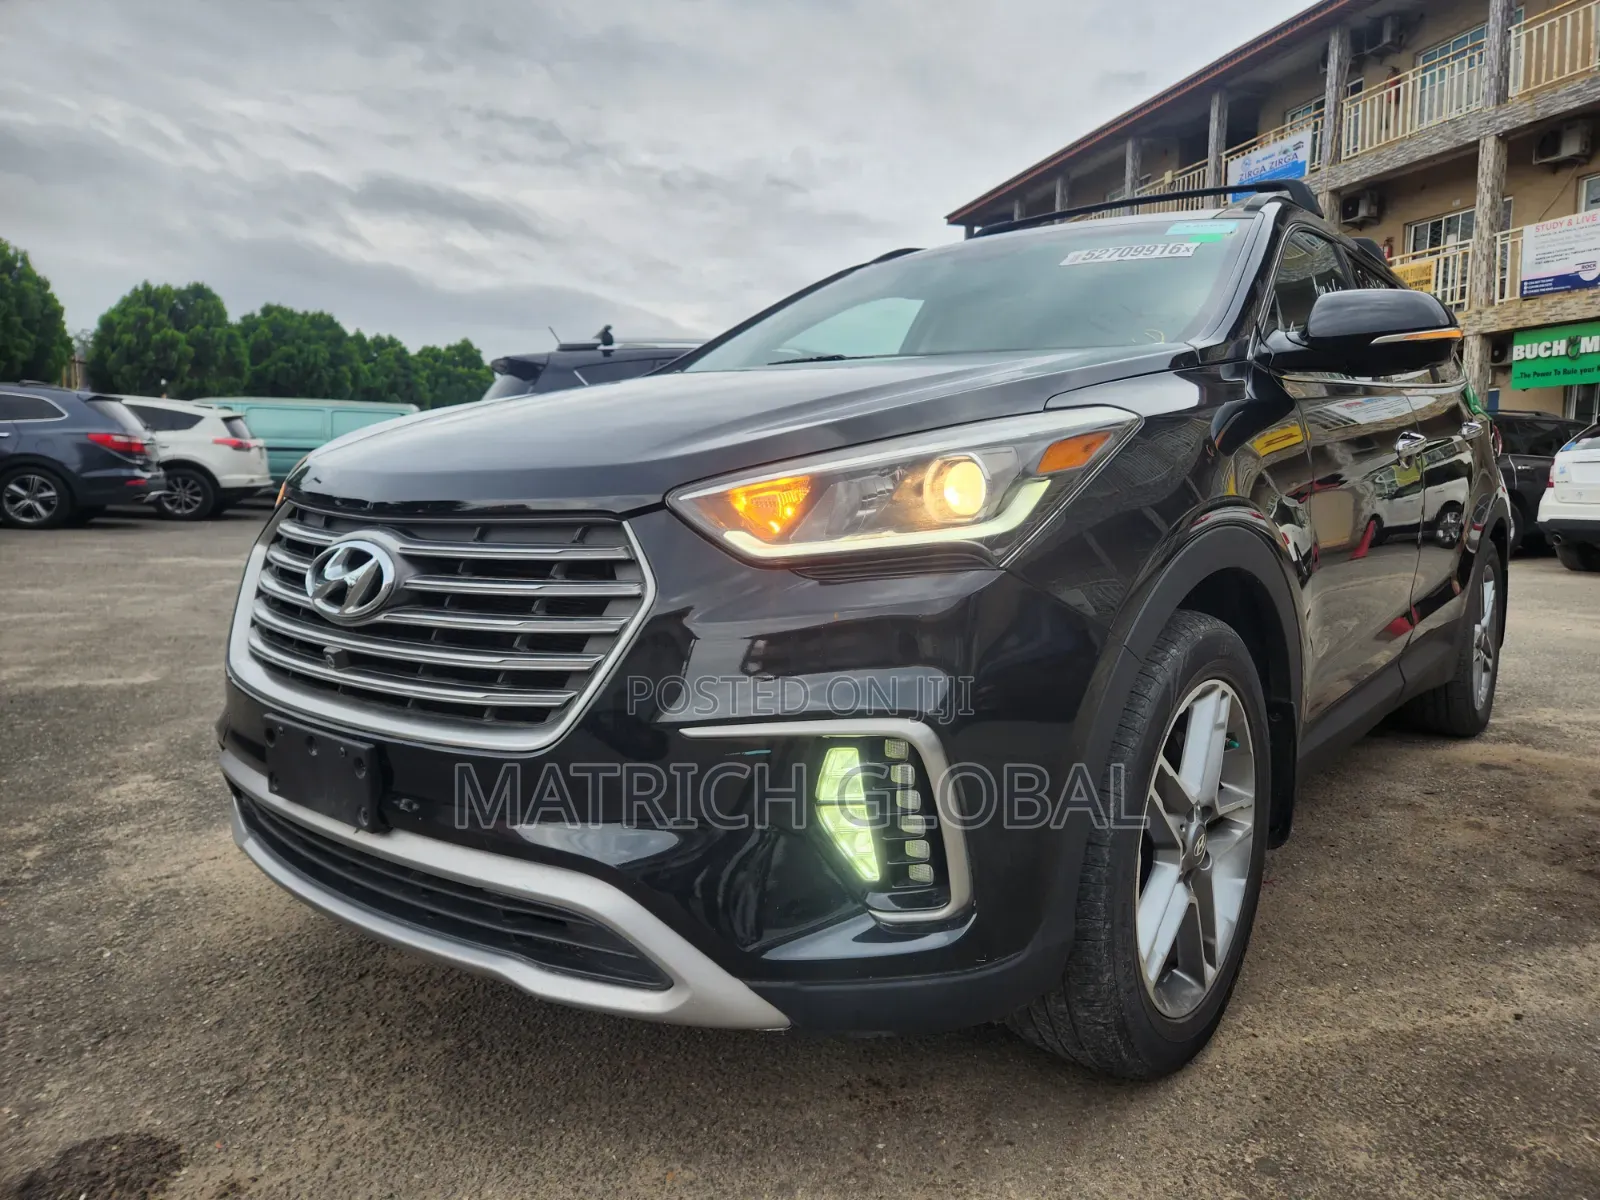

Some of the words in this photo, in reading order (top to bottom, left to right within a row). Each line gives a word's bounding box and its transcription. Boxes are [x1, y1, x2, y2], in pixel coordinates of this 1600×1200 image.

[1239, 165, 1266, 181] ZIRGA
[1269, 152, 1299, 170] ZIRGA
[1535, 220, 1564, 233] STUDY
[1567, 218, 1573, 227] &
[1576, 213, 1598, 225] LIVE
[1580, 367, 1595, 375] your
